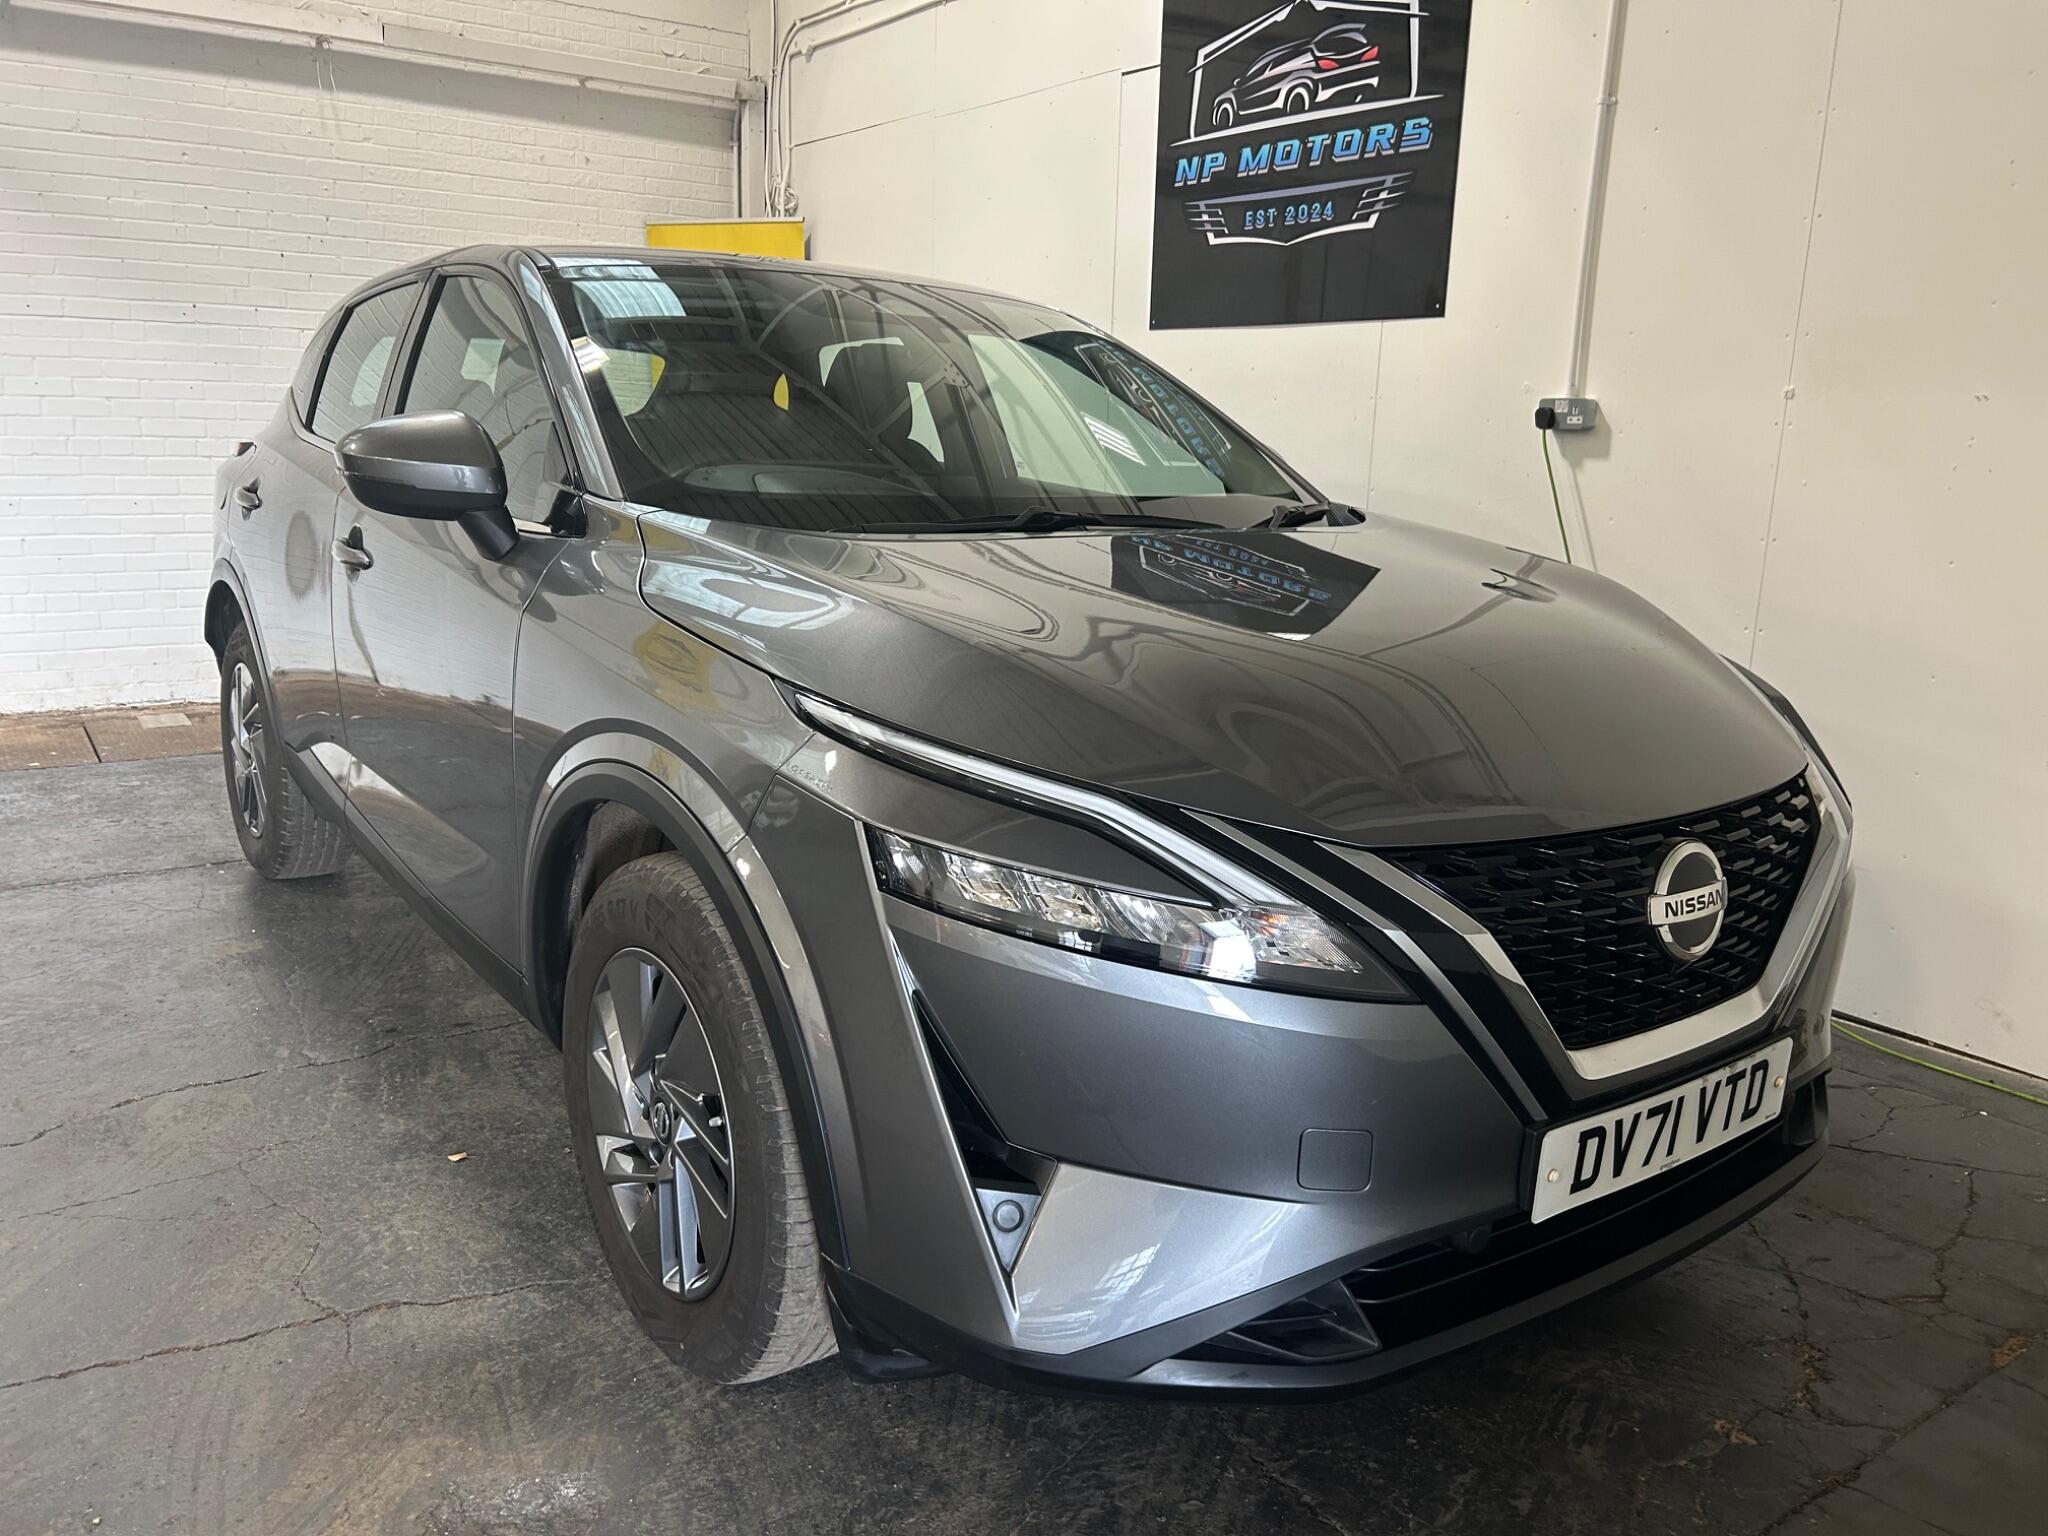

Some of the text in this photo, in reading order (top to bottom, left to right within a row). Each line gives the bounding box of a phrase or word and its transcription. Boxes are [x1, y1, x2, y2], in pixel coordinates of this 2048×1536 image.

[1174, 116, 1435, 187] NP MOTORS
[1243, 201, 1335, 230] EST 2024
[1664, 889, 1723, 918] NISSAN
[1569, 1058, 1770, 1195] DV71 VTD
